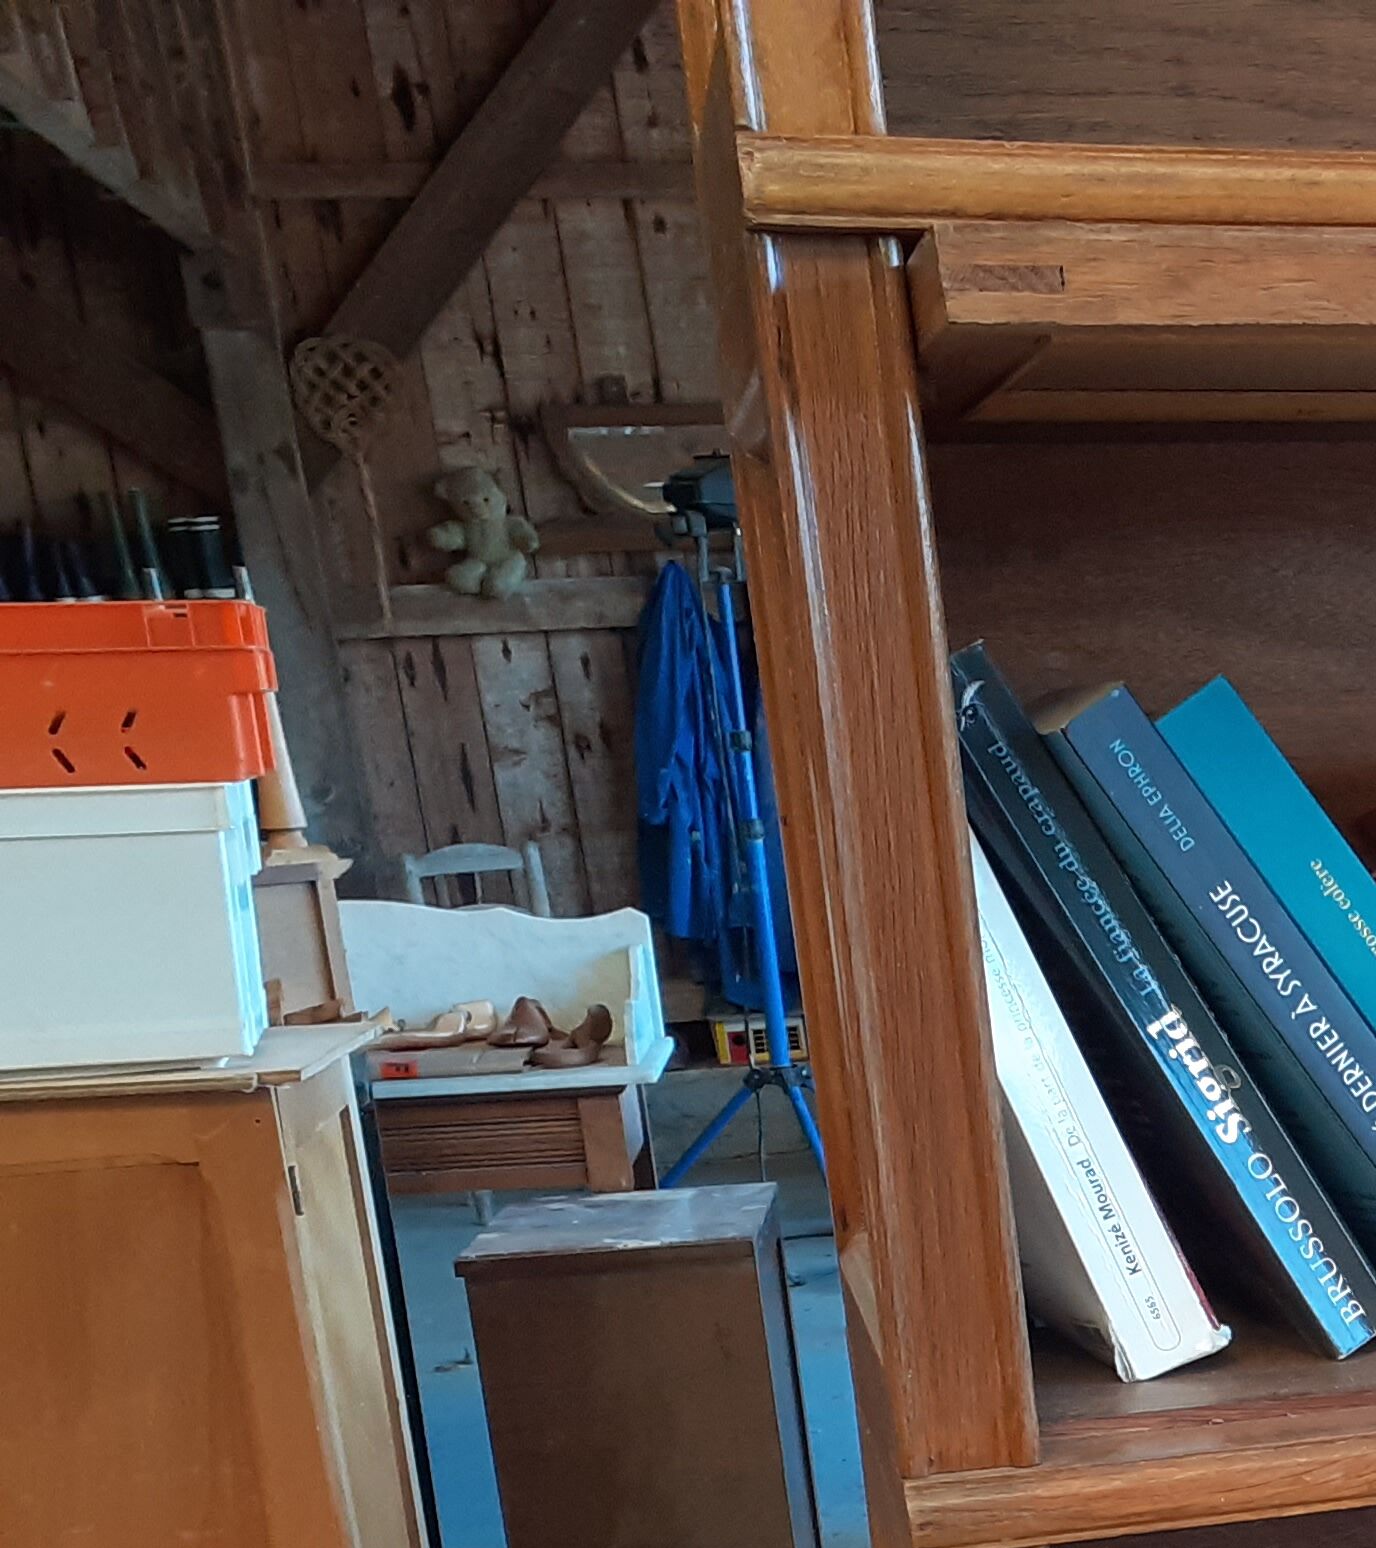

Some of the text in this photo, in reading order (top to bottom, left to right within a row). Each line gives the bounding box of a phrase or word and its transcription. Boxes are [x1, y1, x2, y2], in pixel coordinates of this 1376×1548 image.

[987, 739, 1060, 836] crapaud
[1108, 738, 1195, 851] DELIA EPHRON
[1053, 840, 1081, 872] du
[1309, 859, 1351, 910] colère
[1209, 880, 1301, 996] SYRACUSE
[1289, 992, 1318, 1020] À
[1146, 1006, 1249, 1148] Sigrid
[1065, 1124, 1082, 1148] De
[1076, 1157, 1116, 1221] Mourad
[1107, 1222, 1142, 1276] Kenizé
[1242, 1152, 1364, 1326] BRUSSOLO
[1143, 1294, 1161, 1320] 6565
